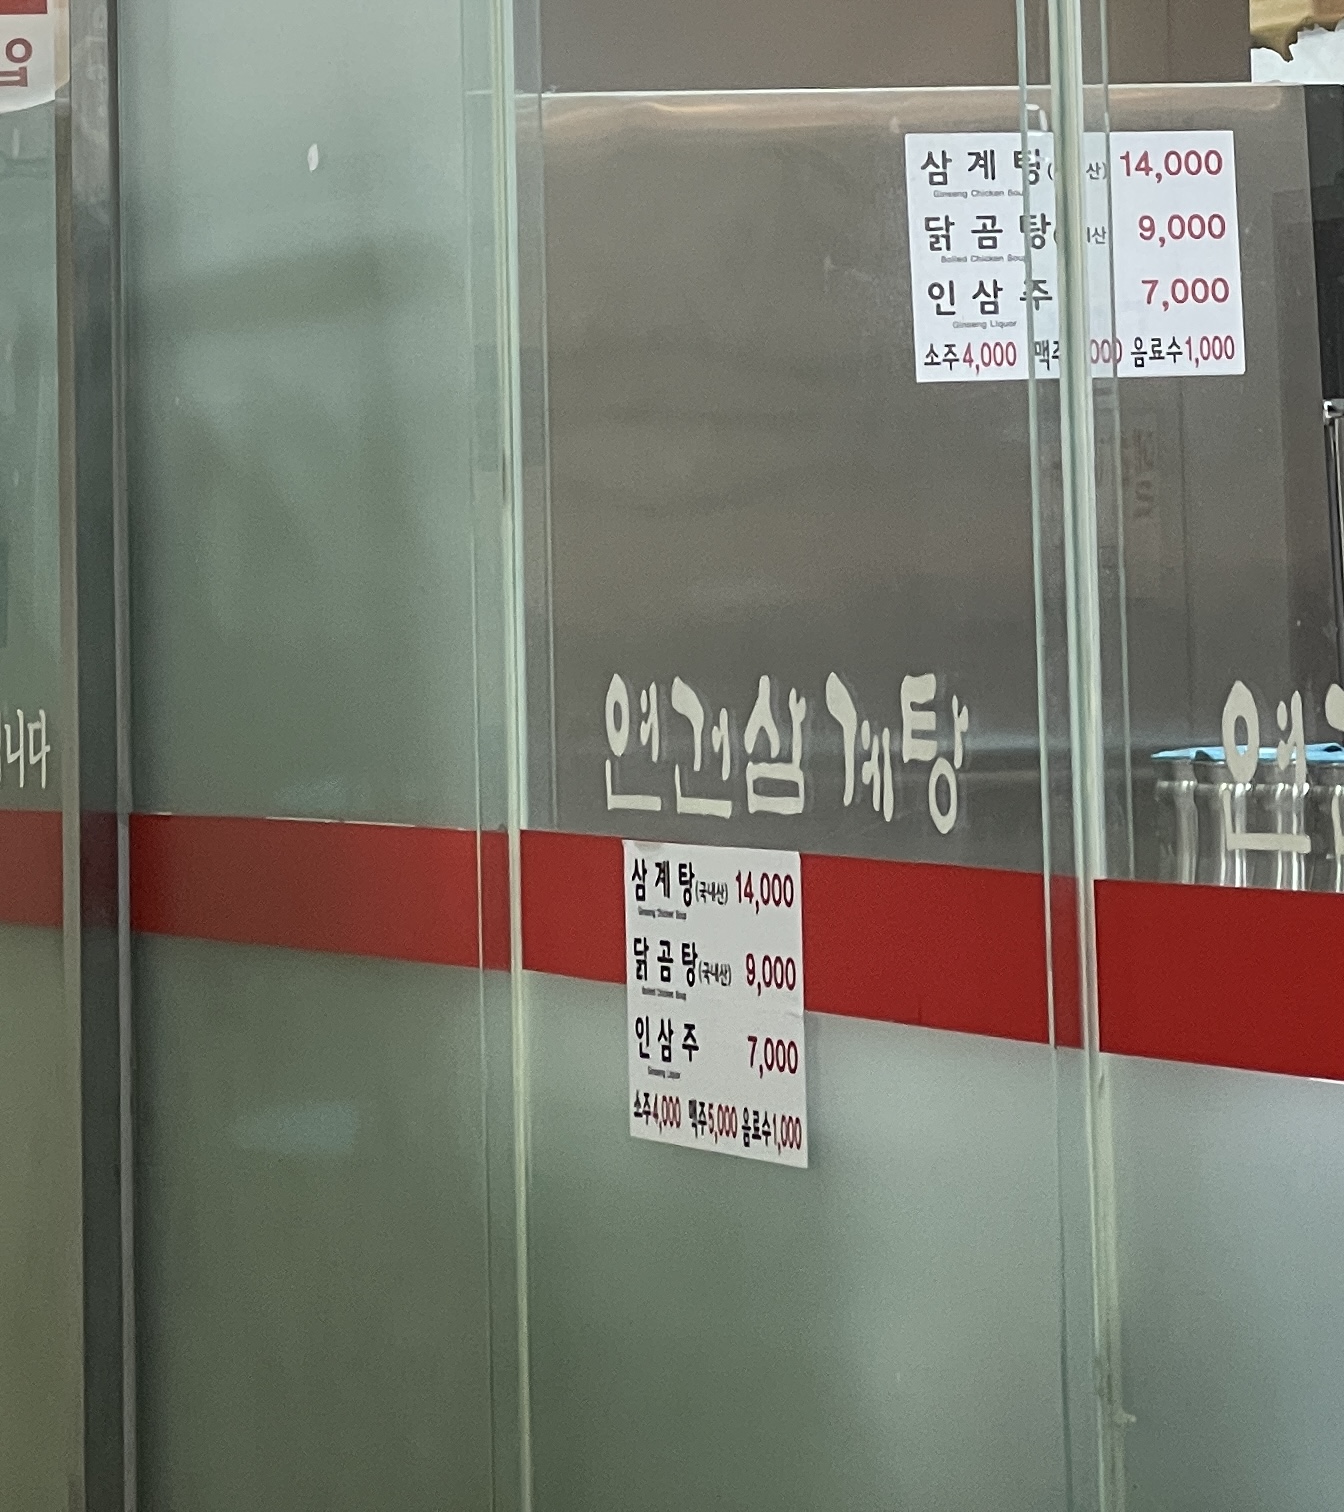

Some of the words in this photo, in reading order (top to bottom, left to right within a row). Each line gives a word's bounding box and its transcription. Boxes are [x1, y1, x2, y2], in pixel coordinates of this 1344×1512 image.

[1119, 149, 1224, 184] 14,000
[1137, 212, 1228, 248] 9,000
[1141, 277, 1230, 312] 7,000
[735, 869, 795, 915] 14,000
[745, 952, 797, 996] 9,000
[747, 1035, 799, 1079] 7,000
